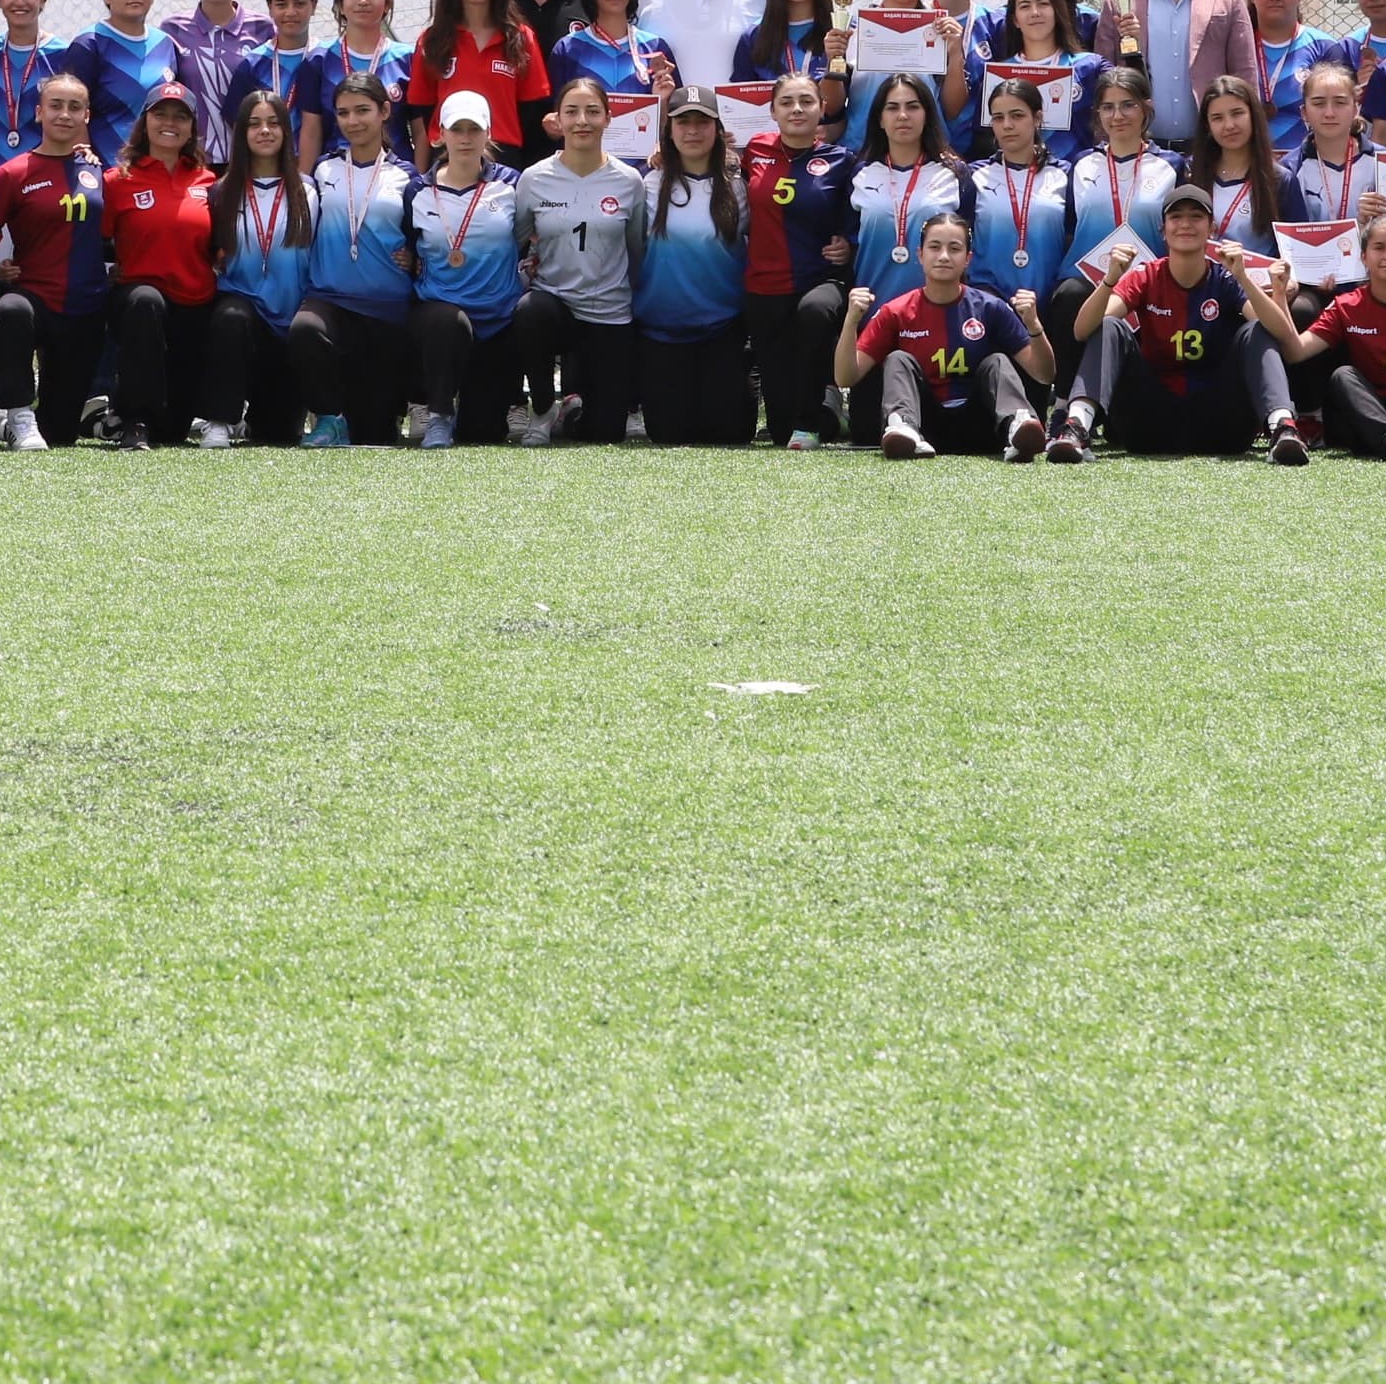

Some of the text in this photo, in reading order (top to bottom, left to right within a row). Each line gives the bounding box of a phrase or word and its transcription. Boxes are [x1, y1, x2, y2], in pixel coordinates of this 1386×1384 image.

[772, 177, 797, 205] 5
[59, 193, 87, 222] 11
[572, 221, 588, 252] 1
[1170, 329, 1204, 361] 13
[931, 347, 969, 378] 14
